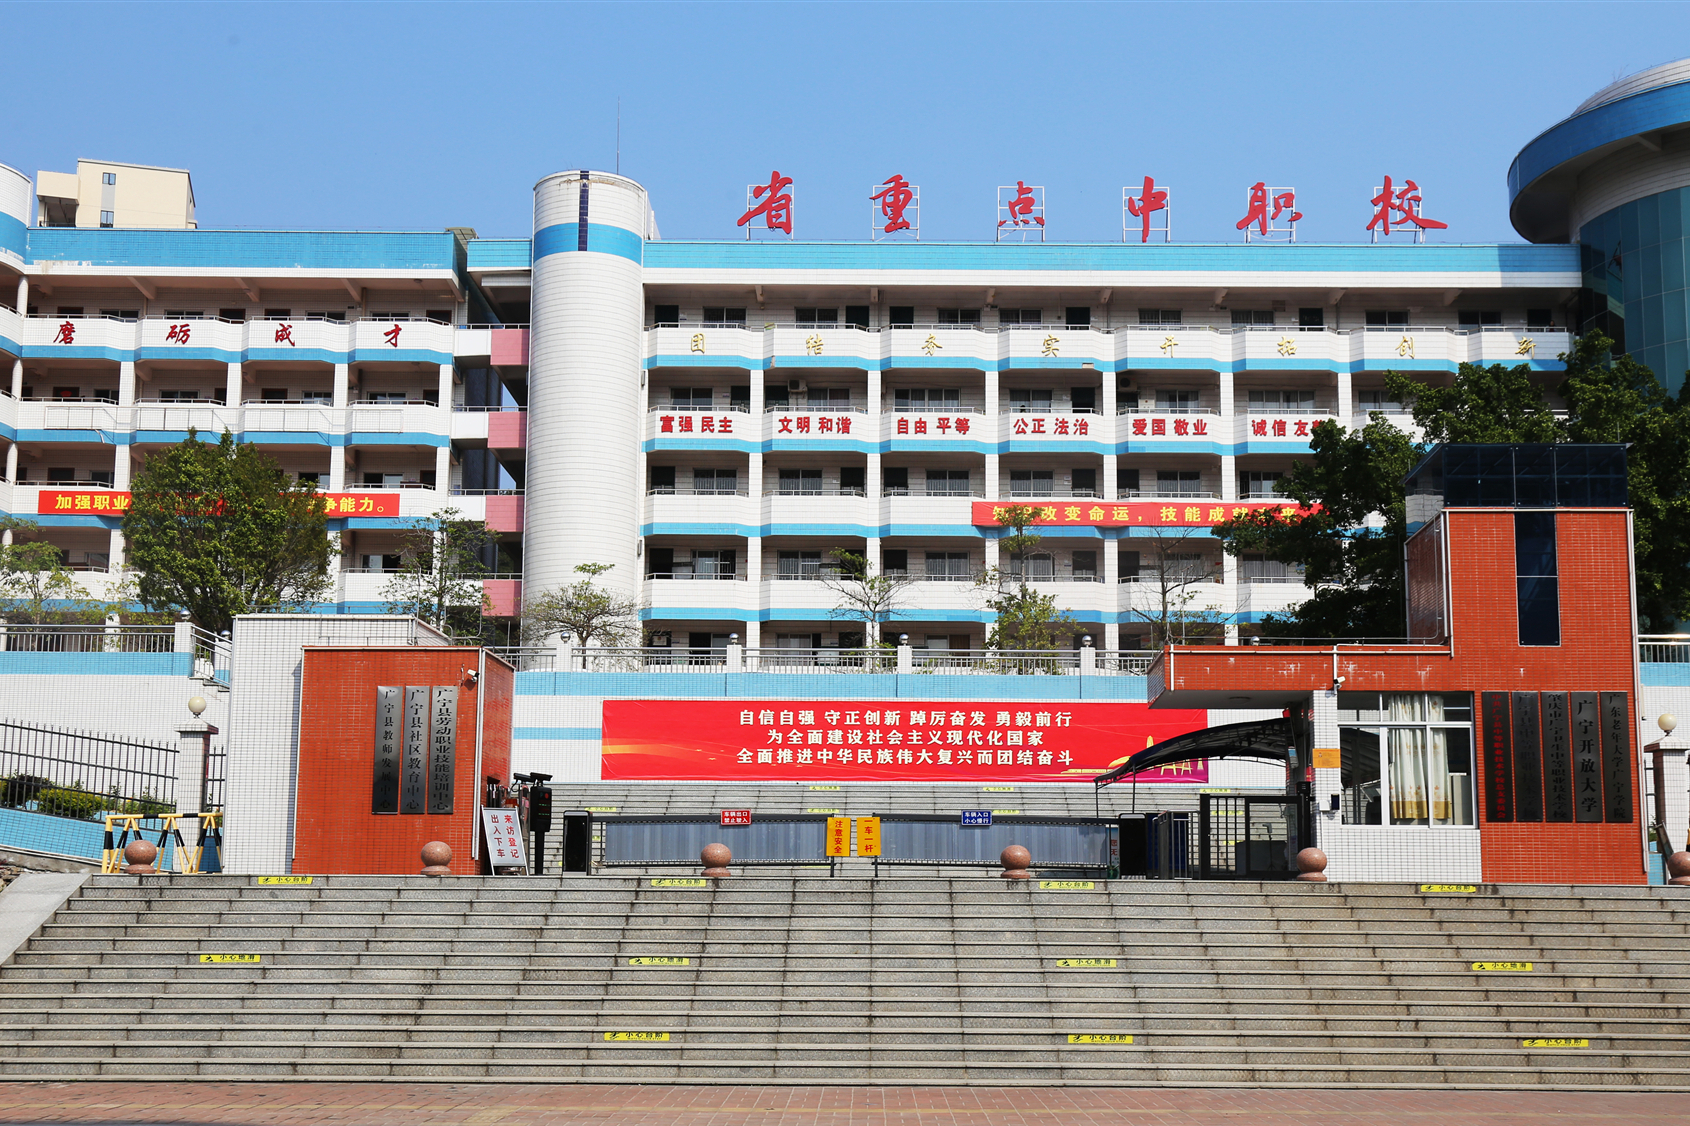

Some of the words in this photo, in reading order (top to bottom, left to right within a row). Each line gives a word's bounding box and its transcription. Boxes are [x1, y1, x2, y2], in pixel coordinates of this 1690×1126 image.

[737, 171, 1449, 243] 省重点中职校
[53, 320, 402, 348] 磨砺成才
[690, 333, 1537, 359] 团结务实开拓创新
[660, 415, 733, 434] 富强民主
[778, 416, 852, 435] 文明和谐
[897, 416, 970, 436] 自由平等
[1013, 417, 1089, 436] 公正法治
[1132, 418, 1208, 437] 爱国敬业
[1252, 419, 1325, 437] 诚信友
[55, 494, 130, 510] 加强职业
[739, 710, 815, 726] 自信自强
[824, 710, 902, 726] 守正创新
[910, 710, 986, 727] 踔厉奋发
[995, 711, 1073, 727] 勇毅前行
[379, 689, 396, 810] 广宁县教师发展中心
[406, 689, 425, 811] 广宁县社区教育中心
[432, 688, 453, 811] 广宁县劳动职业技能培训中心
[767, 729, 1044, 746] 为全面建设社会主义现代化国家
[736, 748, 1074, 766] 全面推进中华民族伟大复兴而团结奋斗
[1577, 699, 1598, 813] 广宁开放大学
[1608, 693, 1627, 819] 广东老年大学广宁学院
[490, 814, 506, 858] 出入下车
[504, 814, 520, 859] 来访登记
[834, 820, 844, 854] 注意安全
[864, 820, 874, 853] 一车一杆
